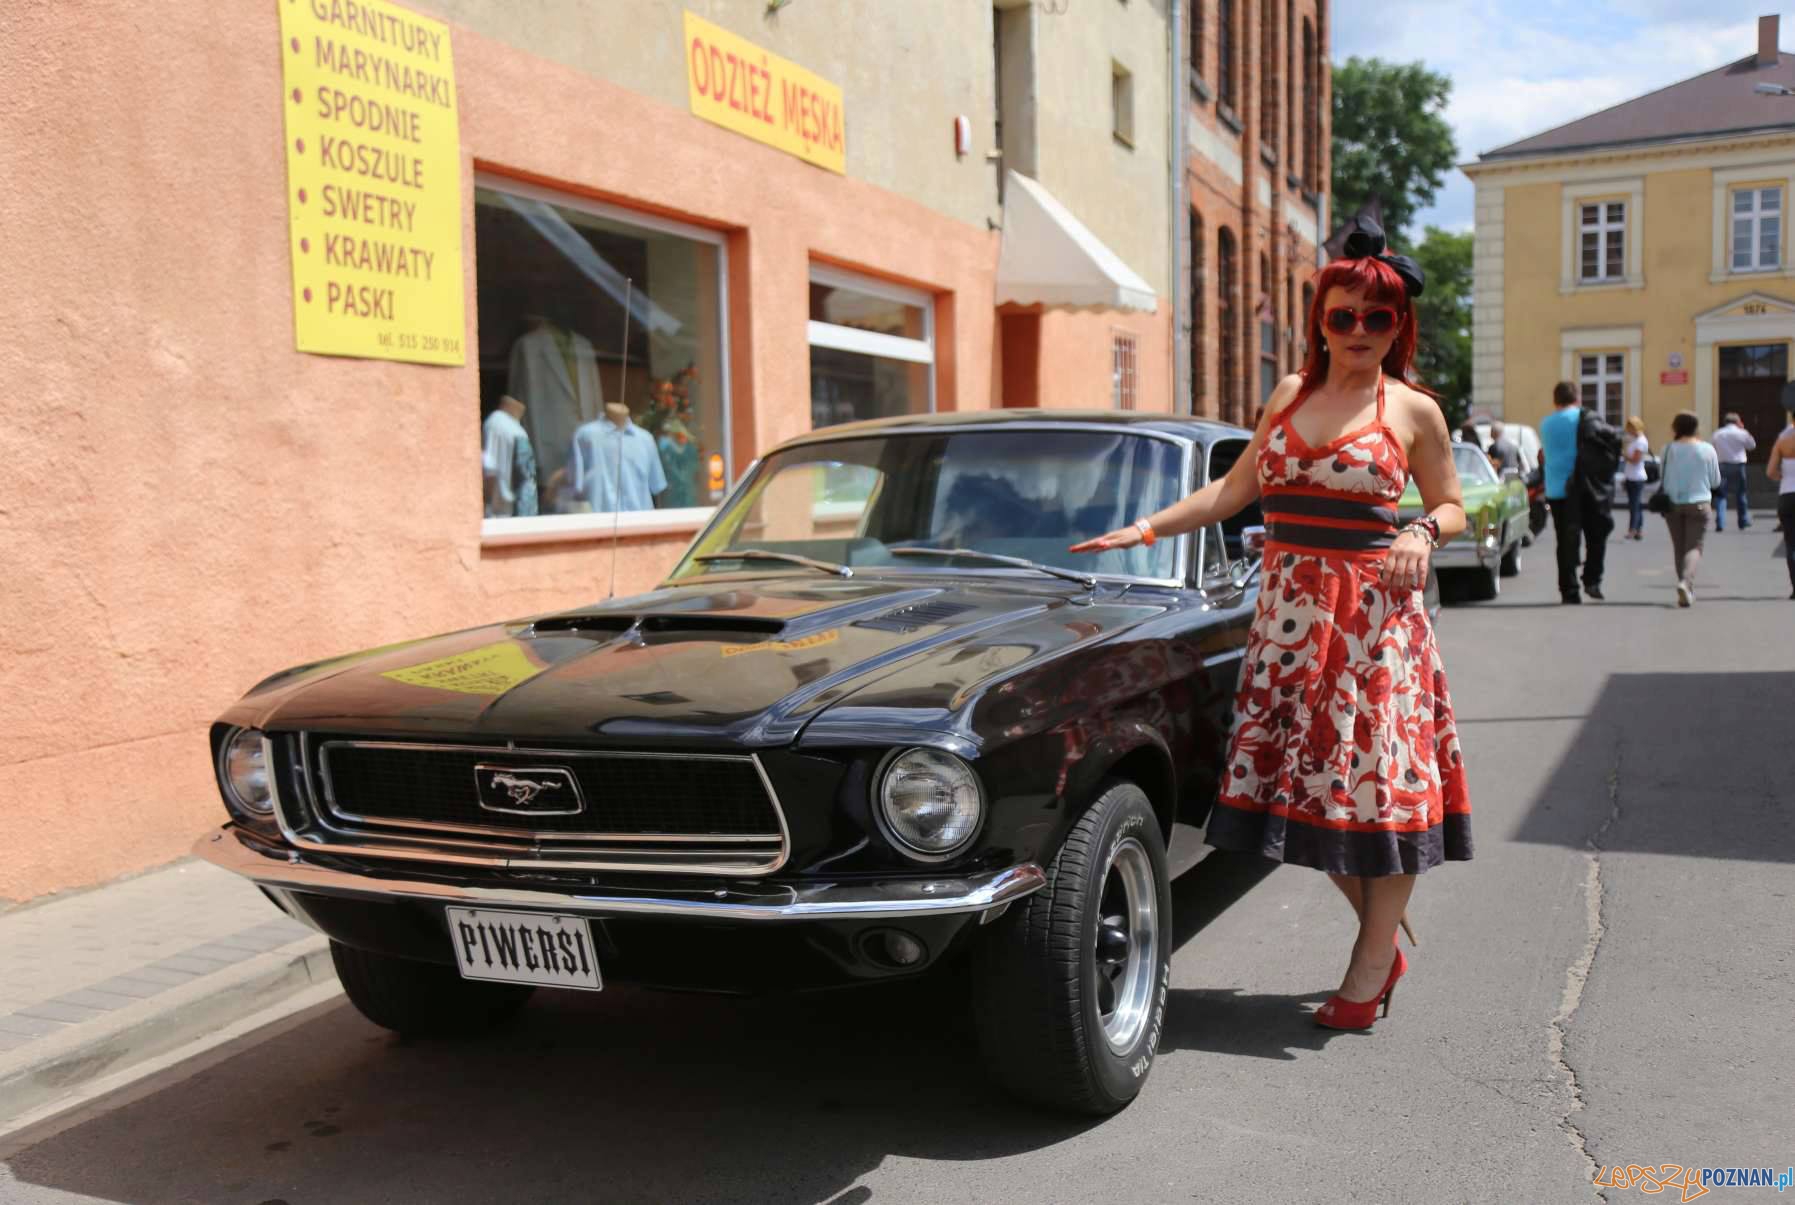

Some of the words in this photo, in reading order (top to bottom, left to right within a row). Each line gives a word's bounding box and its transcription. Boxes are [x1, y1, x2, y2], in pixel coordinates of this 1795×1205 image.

[311, 0, 441, 62] GARNITURY
[315, 36, 451, 108] MARYNARKI
[691, 37, 774, 124] ODZIEŻ
[781, 77, 845, 153] MĘSKA
[317, 86, 422, 144] SPODNIE
[320, 135, 424, 189] KOSZULE
[322, 185, 416, 233] SWETRY
[324, 233, 434, 281] KRAWATY
[327, 282, 395, 321] PASKI
[458, 917, 591, 977] PIWERSI
